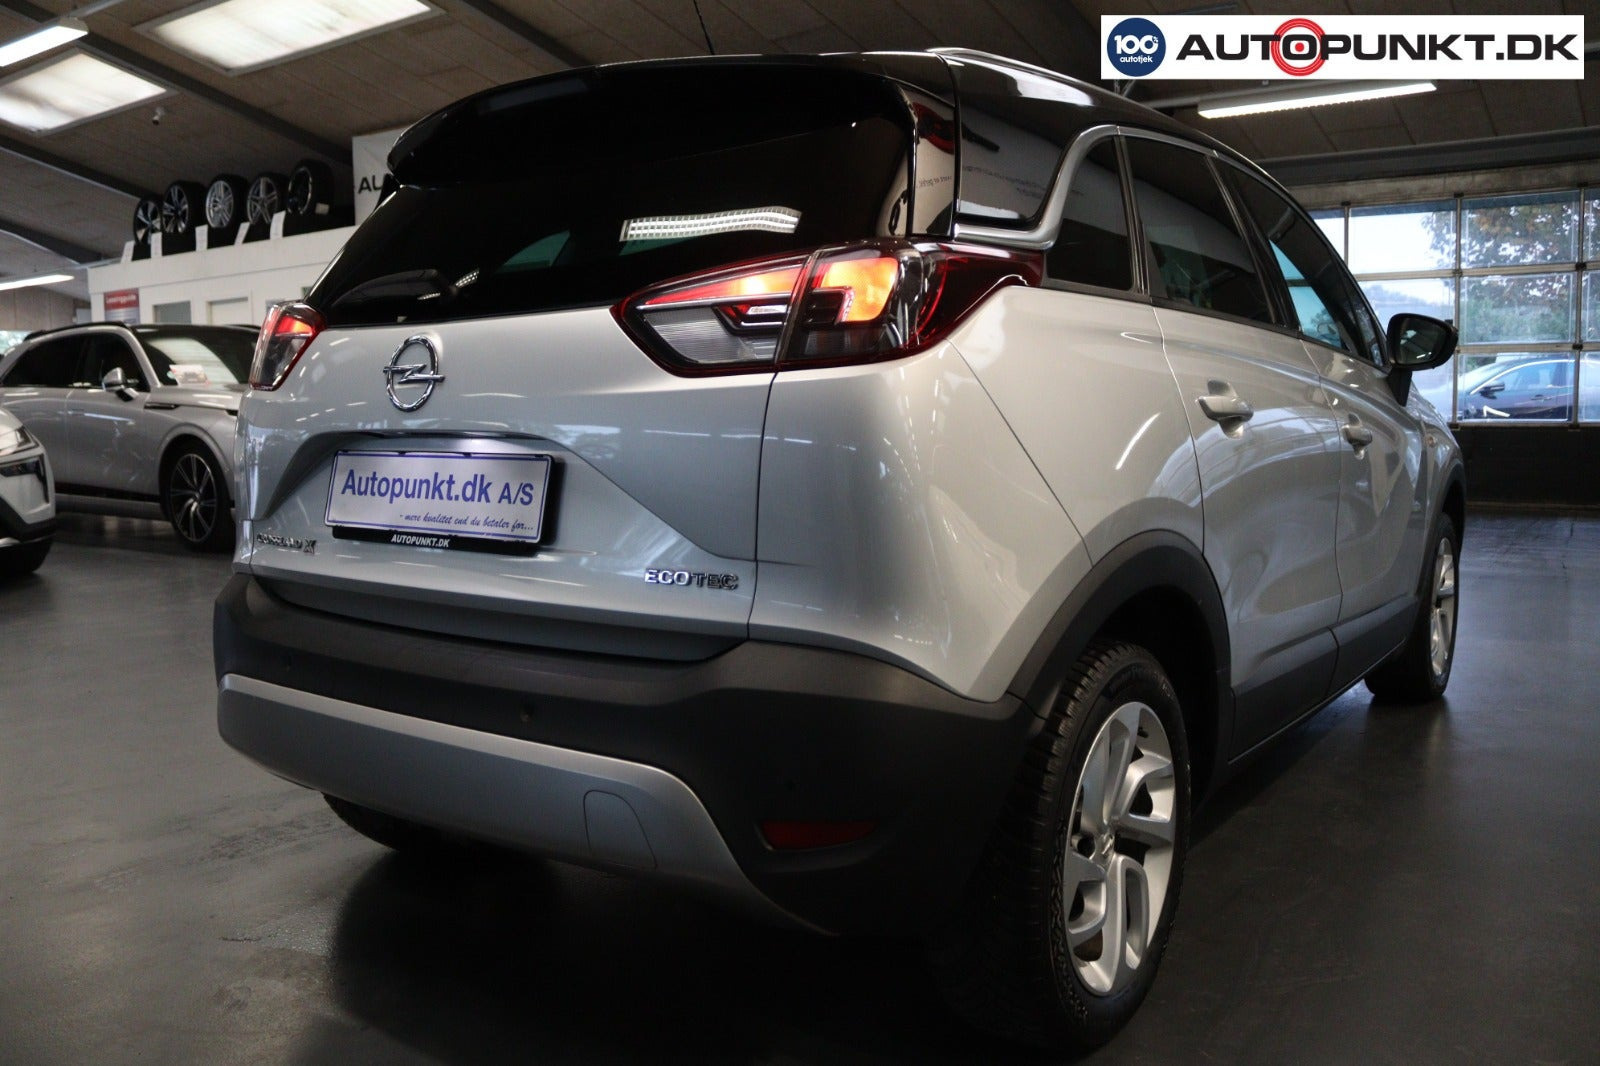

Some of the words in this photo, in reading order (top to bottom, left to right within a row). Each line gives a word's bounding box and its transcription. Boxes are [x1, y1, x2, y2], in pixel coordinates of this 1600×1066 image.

[341, 469, 492, 504] Autopunkt.dk
[498, 482, 534, 505] A/S
[423, 512, 451, 525] kvalitet
[454, 516, 467, 525] end
[470, 516, 481, 526] du
[483, 517, 509, 529] betaler
[391, 534, 450, 548] AUTOPUNKT.DK
[644, 569, 738, 590] ECOTEC
